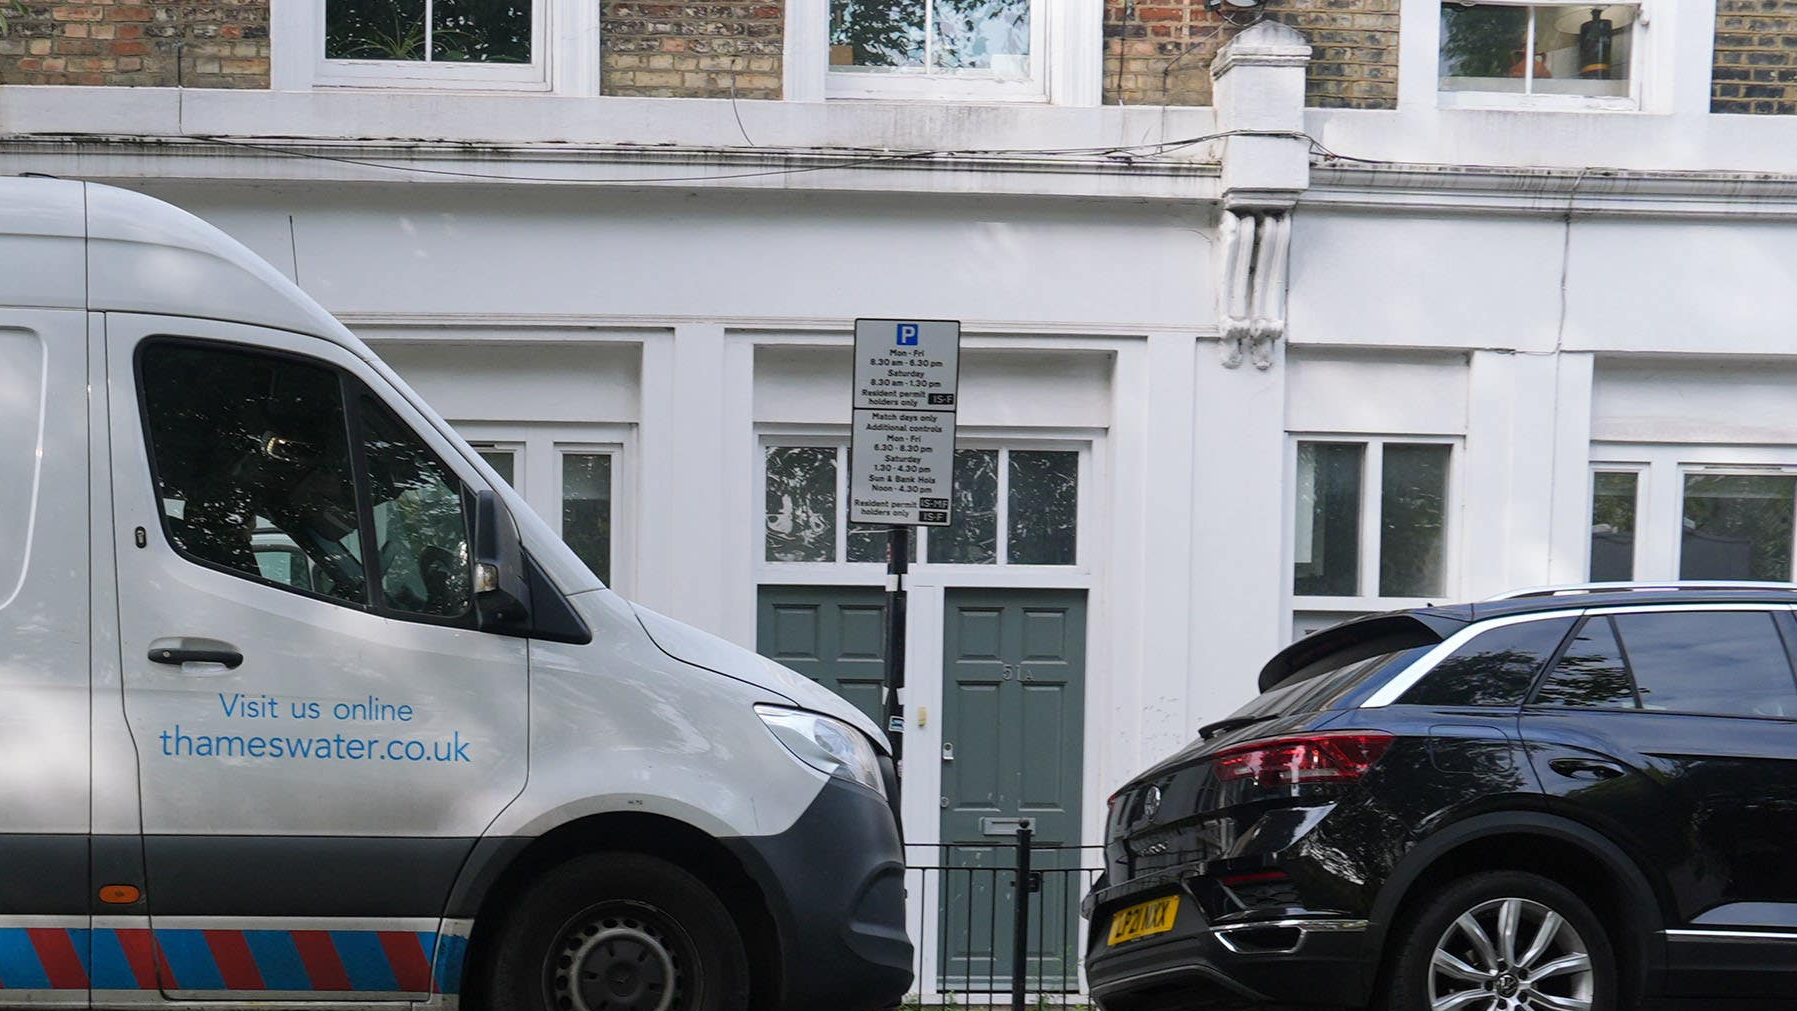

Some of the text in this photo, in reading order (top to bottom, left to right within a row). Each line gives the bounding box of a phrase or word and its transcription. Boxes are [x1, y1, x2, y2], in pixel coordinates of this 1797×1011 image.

[901, 326, 916, 343] P
[909, 359, 929, 367] 6.30
[888, 369, 925, 378] Saturday
[910, 380, 928, 388] 1.30
[862, 389, 926, 398] Resident permit
[868, 398, 918, 407] holders only
[933, 395, 953, 404] IS-F
[872, 412, 897, 420] Match
[920, 414, 938, 423] only
[866, 423, 942, 433] Additional controls
[886, 434, 904, 442] Mon
[884, 454, 922, 464] Saturday
[874, 464, 891, 472] 1.30
[897, 465, 917, 473] 4.30
[868, 474, 885, 482] Sun
[895, 475, 916, 483] Bank
[917, 476, 936, 484] Hols
[871, 484, 893, 492] Noon
[899, 485, 918, 493] 4.30
[854, 499, 889, 507] Resident
[861, 508, 909, 518] holders only
[923, 512, 944, 521] IS-F
[1003, 664, 1035, 682] 51A
[219, 693, 413, 722] Visit us online
[159, 725, 471, 762] thameswater.co.uk
